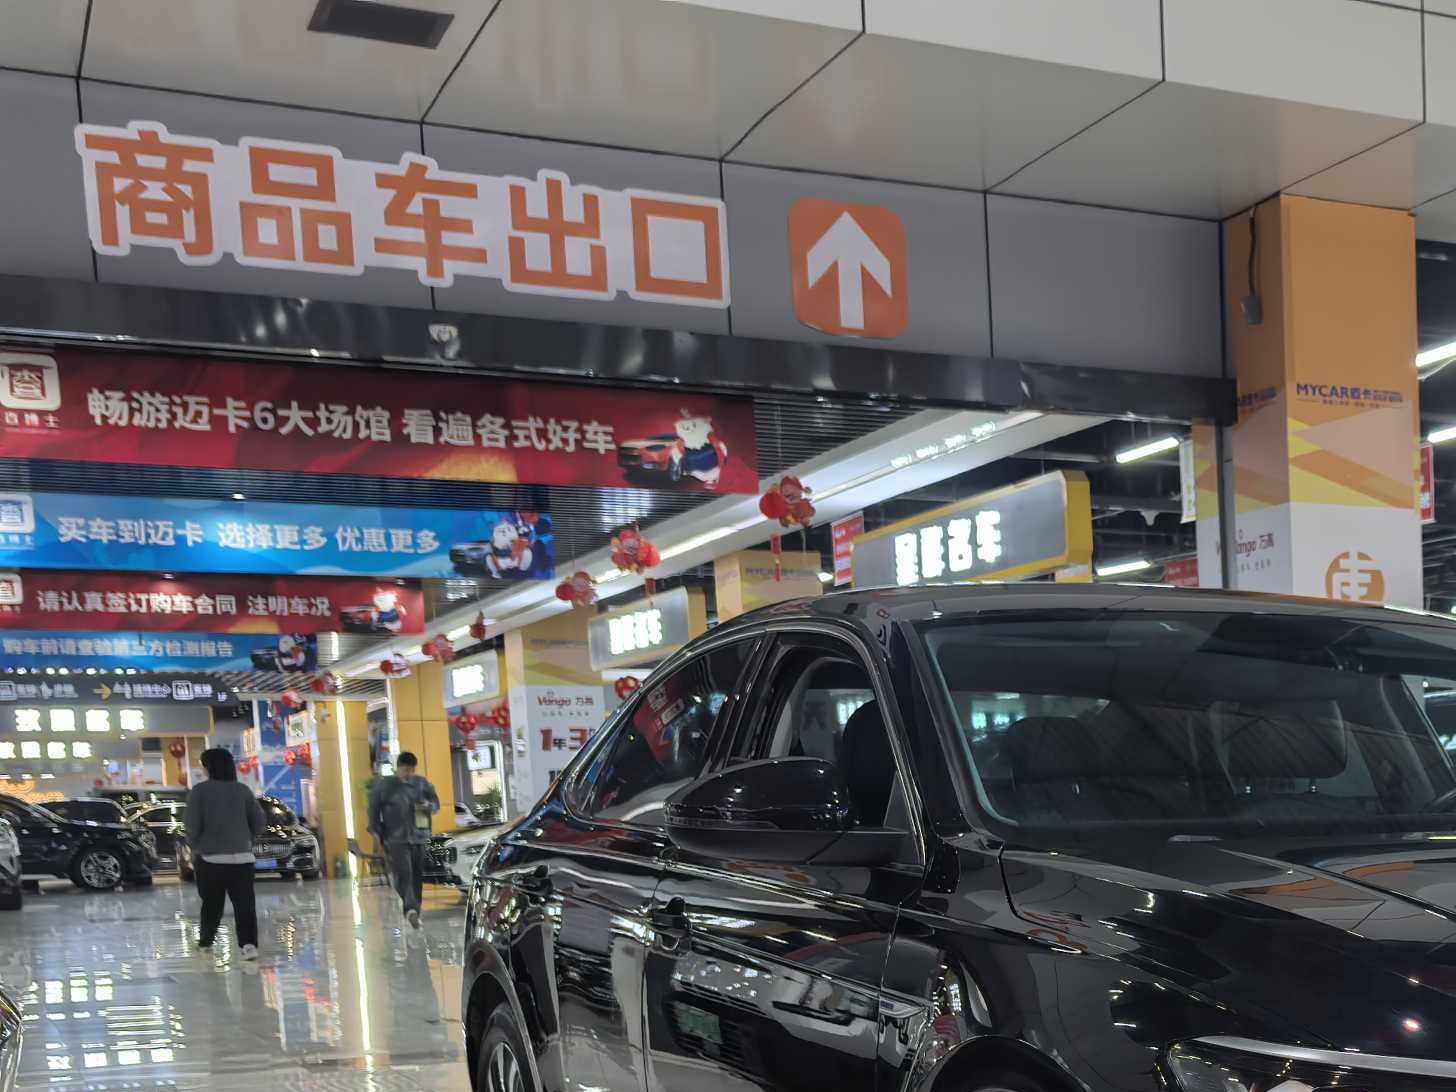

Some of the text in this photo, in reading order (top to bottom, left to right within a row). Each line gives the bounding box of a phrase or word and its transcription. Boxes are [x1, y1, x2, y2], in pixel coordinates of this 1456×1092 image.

[82, 128, 728, 302] 商品车出口
[86, 387, 618, 455] 畅游迈卡6大场馆 看遍各式好车
[57, 516, 441, 554] 买车到迈卡 选择更多 优惠更多
[37, 590, 332, 617] 请认真签订购车合同 注明车况
